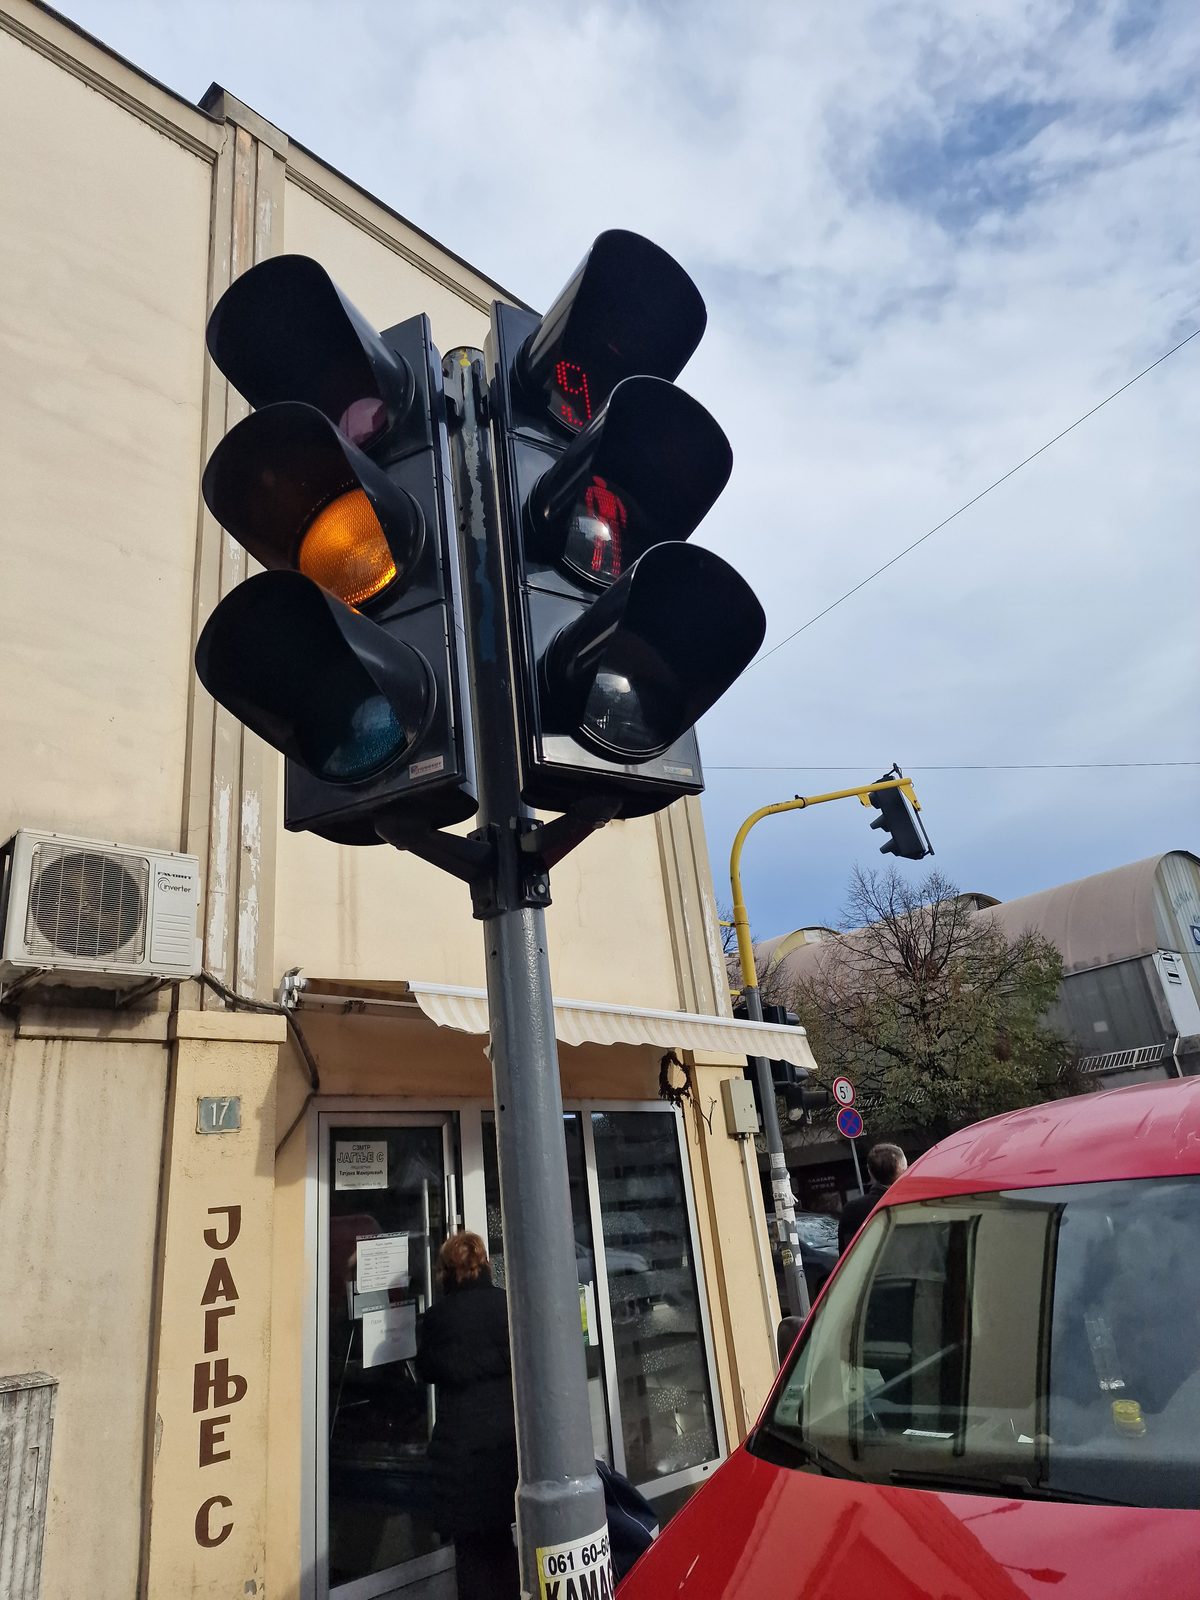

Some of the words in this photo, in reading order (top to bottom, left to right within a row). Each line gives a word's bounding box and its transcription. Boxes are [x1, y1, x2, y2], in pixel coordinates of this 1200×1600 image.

[210, 1098, 231, 1126] 17
[376, 1151, 384, 1162] С
[192, 1204, 249, 1468] ЈАГЊЕ
[194, 1494, 235, 1548] С
[548, 1551, 575, 1575] 061
